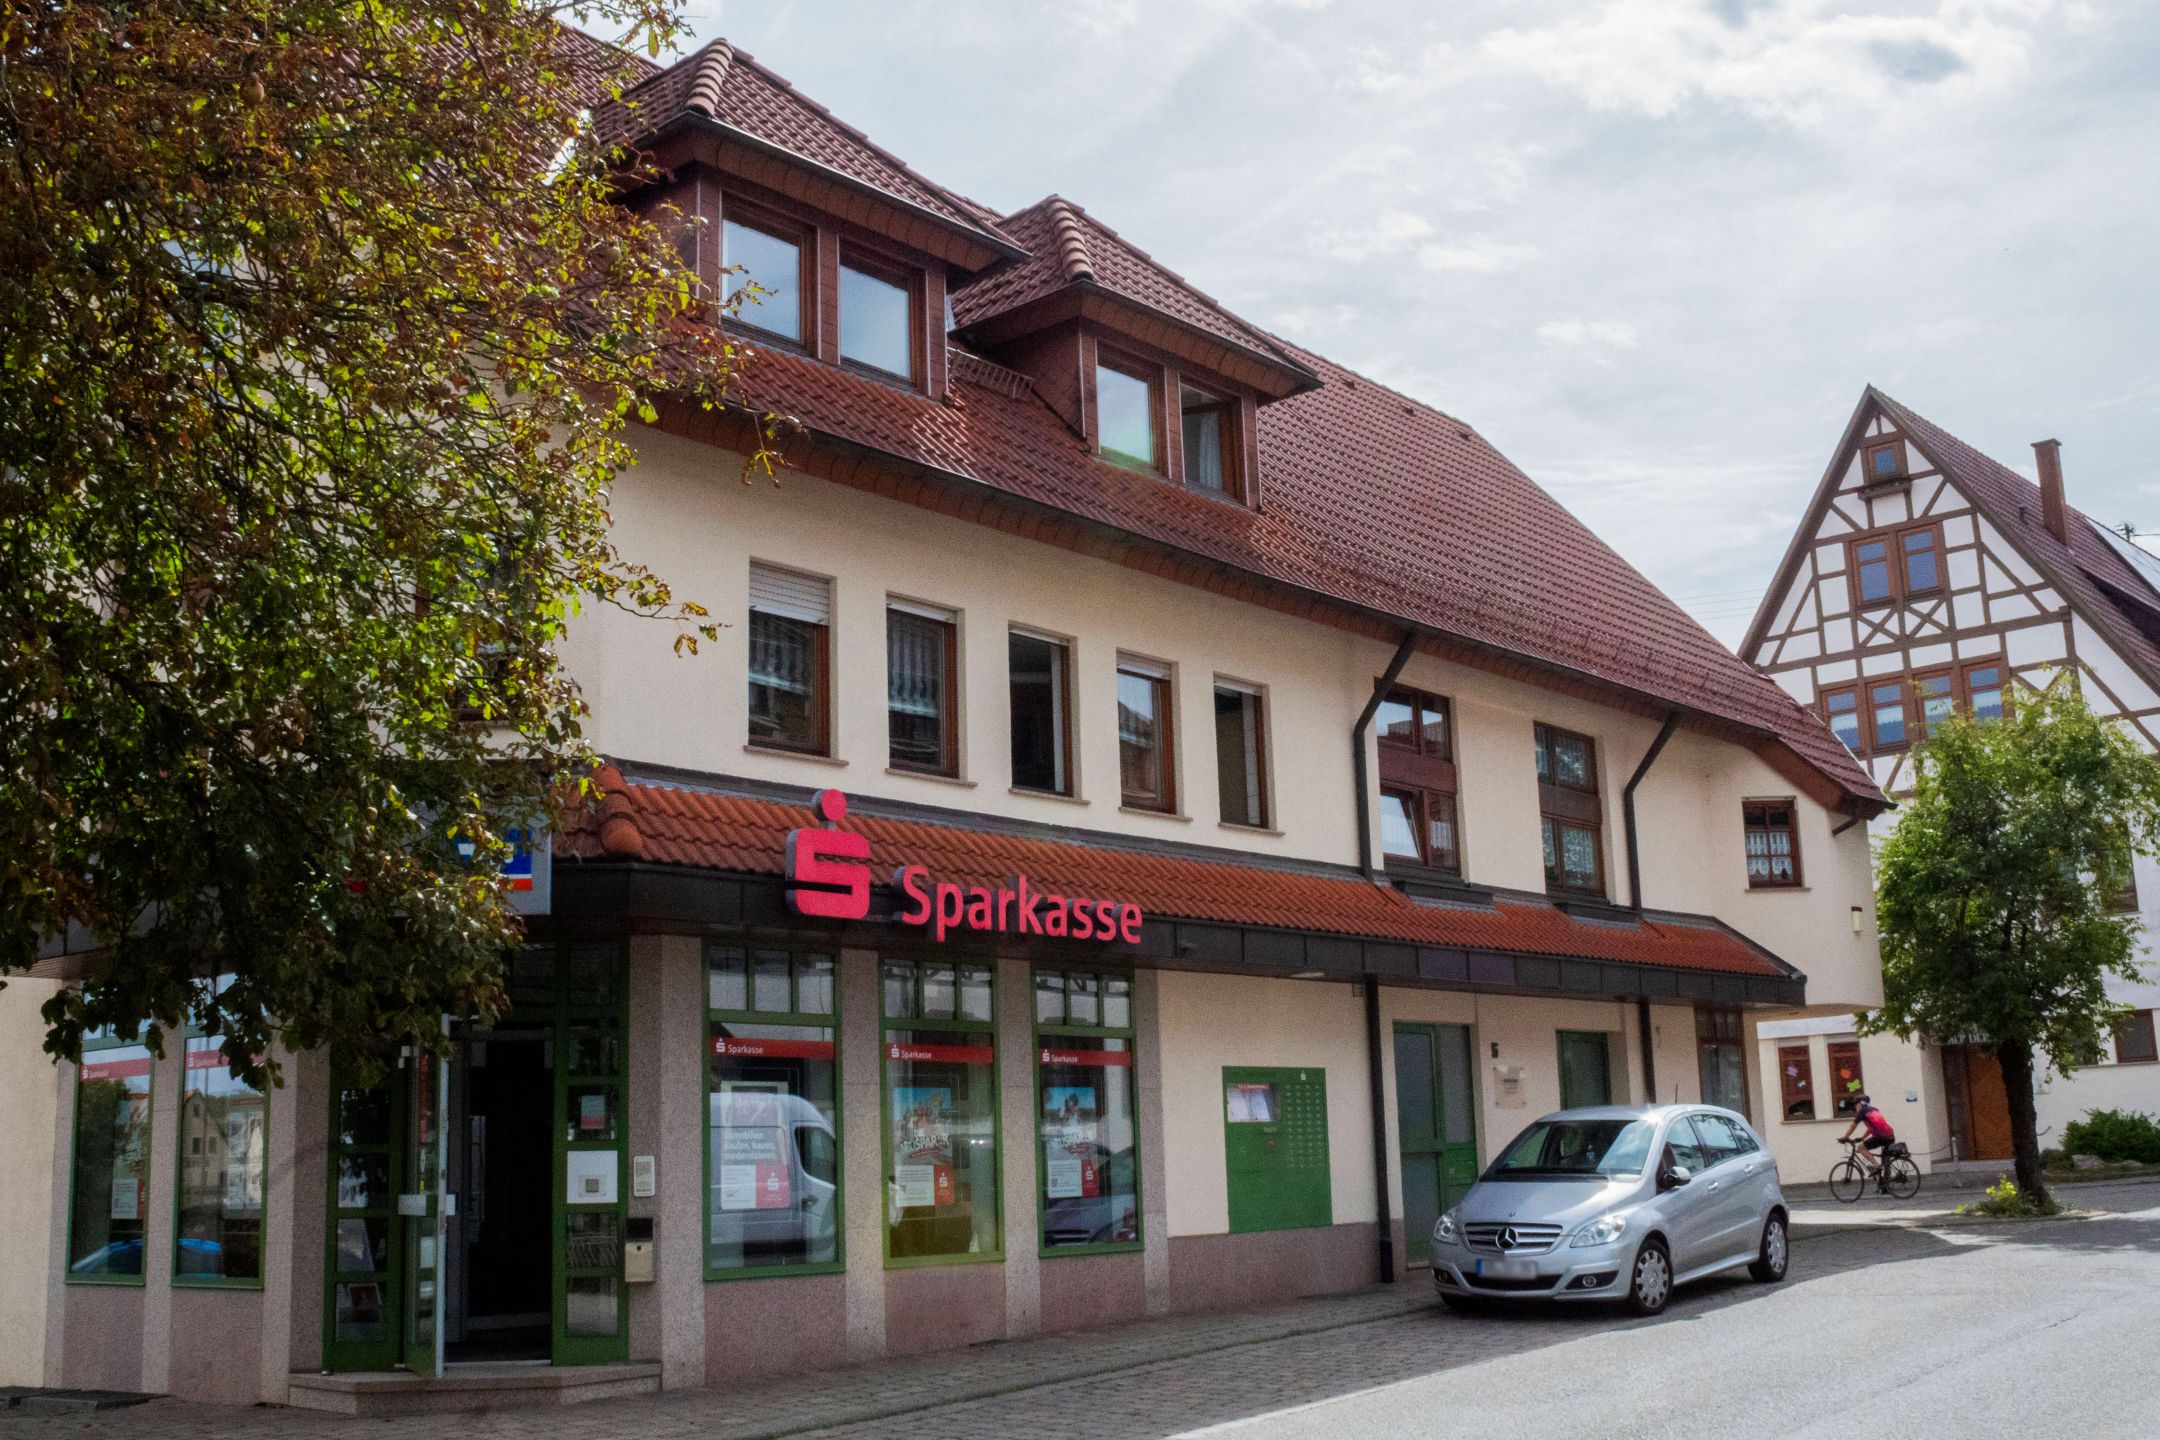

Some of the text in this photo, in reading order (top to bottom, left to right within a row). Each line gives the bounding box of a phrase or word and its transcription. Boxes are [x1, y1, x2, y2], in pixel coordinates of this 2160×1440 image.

[899, 865, 1143, 944] Sparkasse
[727, 1044, 764, 1055] Sparkasse
[901, 1050, 932, 1060] Sparkasse
[1051, 1054, 1079, 1064] Sparkasse
